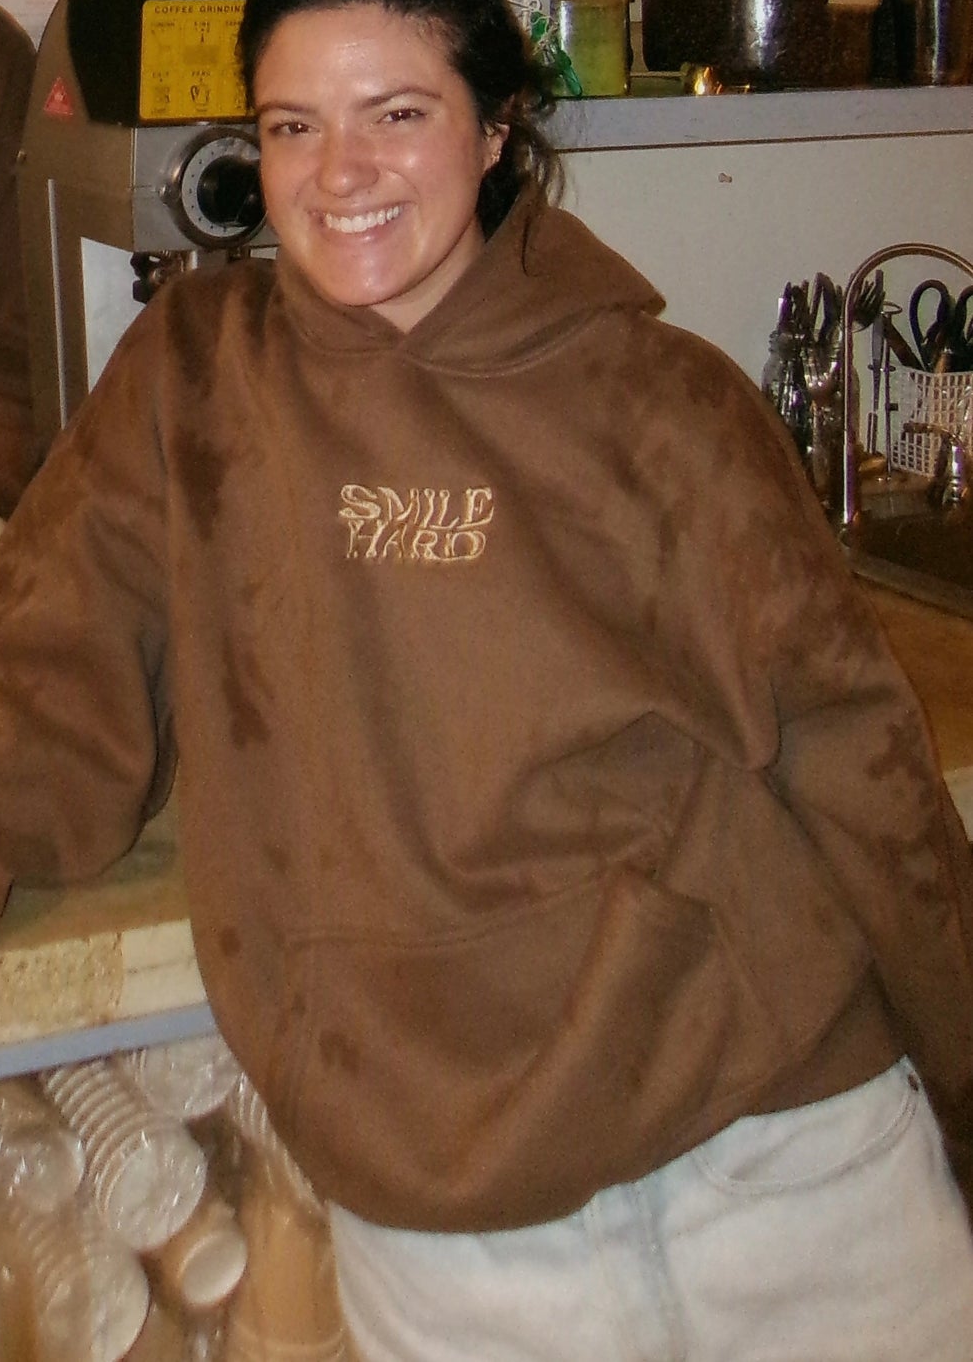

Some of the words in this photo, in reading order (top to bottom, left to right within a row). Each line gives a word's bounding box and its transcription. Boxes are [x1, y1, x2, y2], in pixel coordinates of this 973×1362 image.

[154, 5, 194, 15] COFFEE
[338, 484, 495, 530] SMILE
[346, 520, 487, 562] HARD
